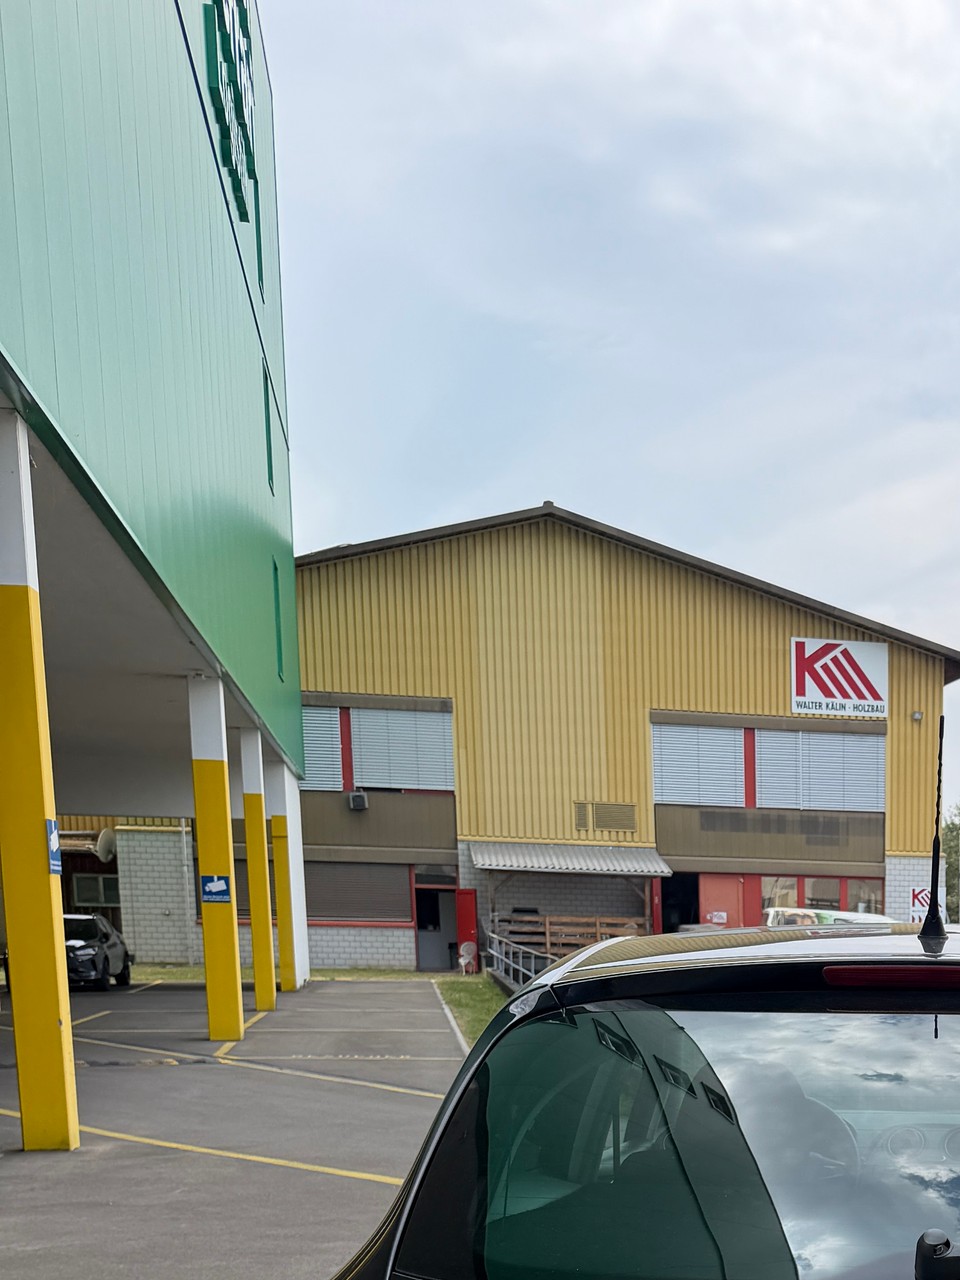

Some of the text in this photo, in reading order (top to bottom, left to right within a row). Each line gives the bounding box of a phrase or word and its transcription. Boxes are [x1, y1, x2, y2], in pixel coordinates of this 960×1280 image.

[795, 700, 885, 714] WALTER KÄLIN HOLZBAU
